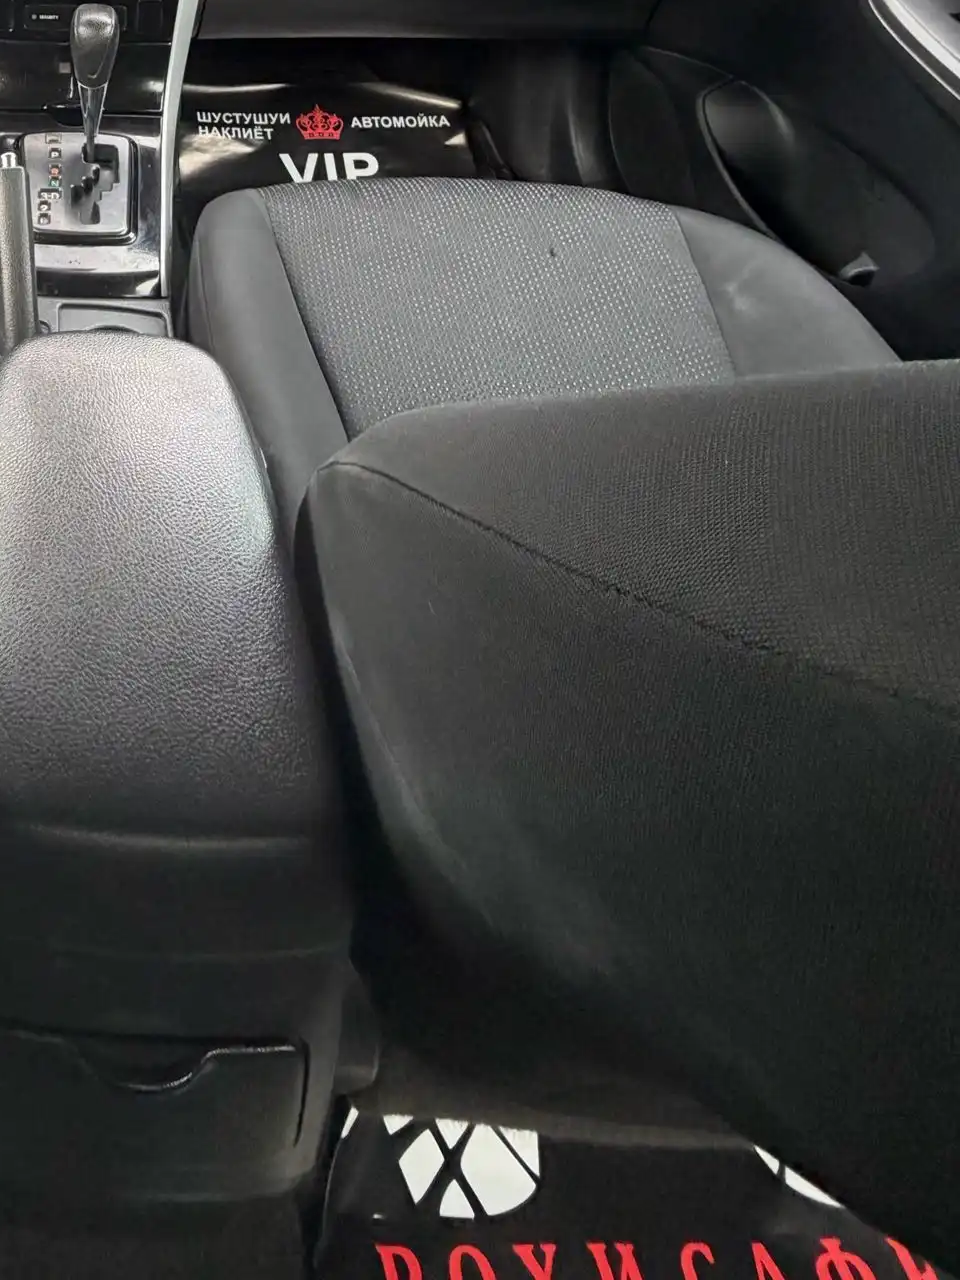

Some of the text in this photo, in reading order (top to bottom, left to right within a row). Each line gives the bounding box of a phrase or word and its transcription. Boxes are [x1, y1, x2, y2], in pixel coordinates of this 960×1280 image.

[196, 111, 291, 125] ШУСТУШУИ
[350, 112, 450, 130] АВТОМОЙКА
[278, 152, 379, 184] VIP
